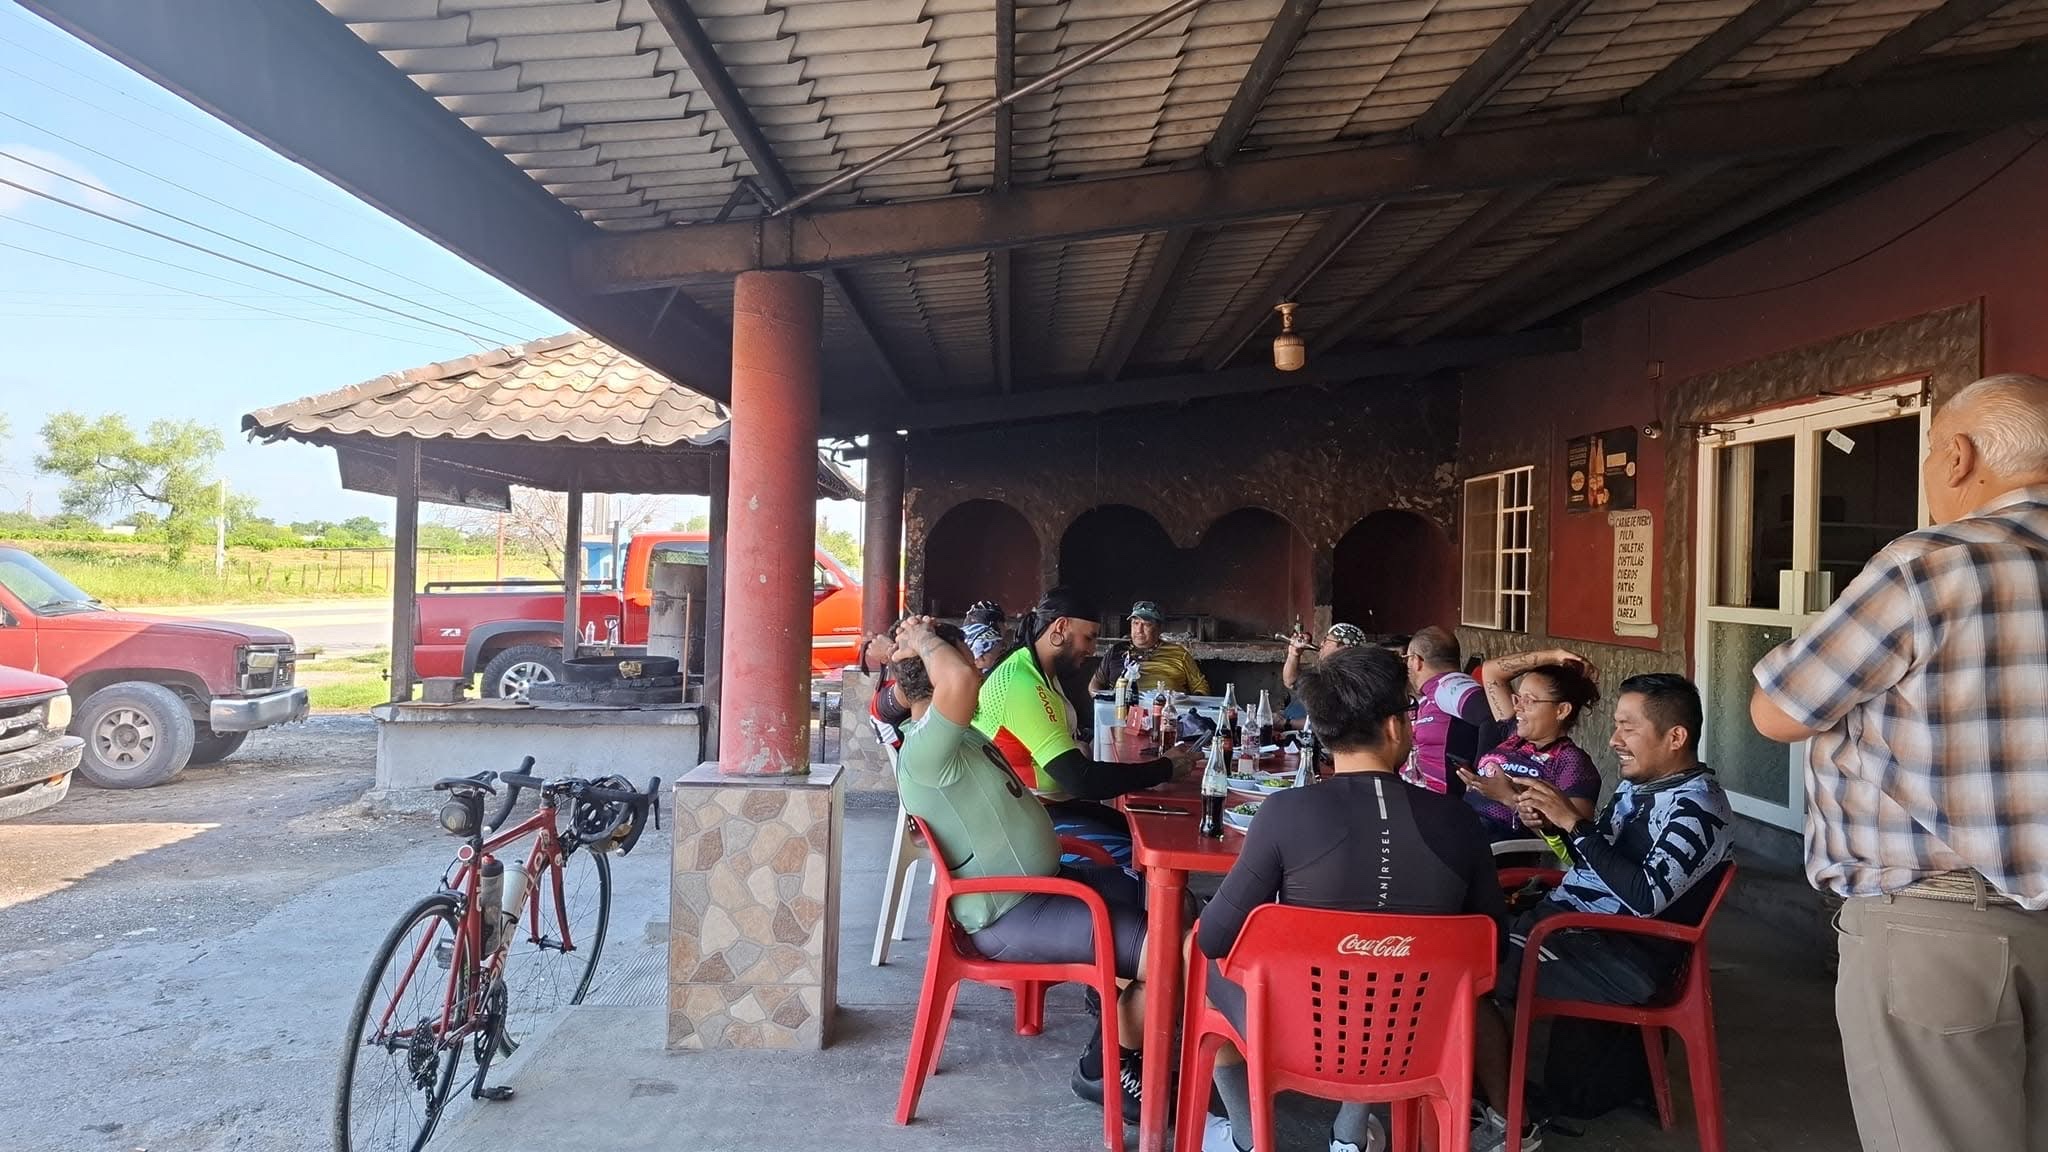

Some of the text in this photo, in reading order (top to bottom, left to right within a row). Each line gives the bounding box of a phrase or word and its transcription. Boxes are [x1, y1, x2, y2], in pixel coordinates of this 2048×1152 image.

[1617, 556, 1645, 567] COSTILLAS
[1617, 569, 1639, 580] CUEROS
[1617, 582, 1635, 593] PATAS
[1617, 595, 1643, 606] MANTECA
[1617, 607, 1637, 619] CABEZA
[1036, 684, 1057, 723] ROVOS
[1337, 933, 1416, 957] Coca-Cola
